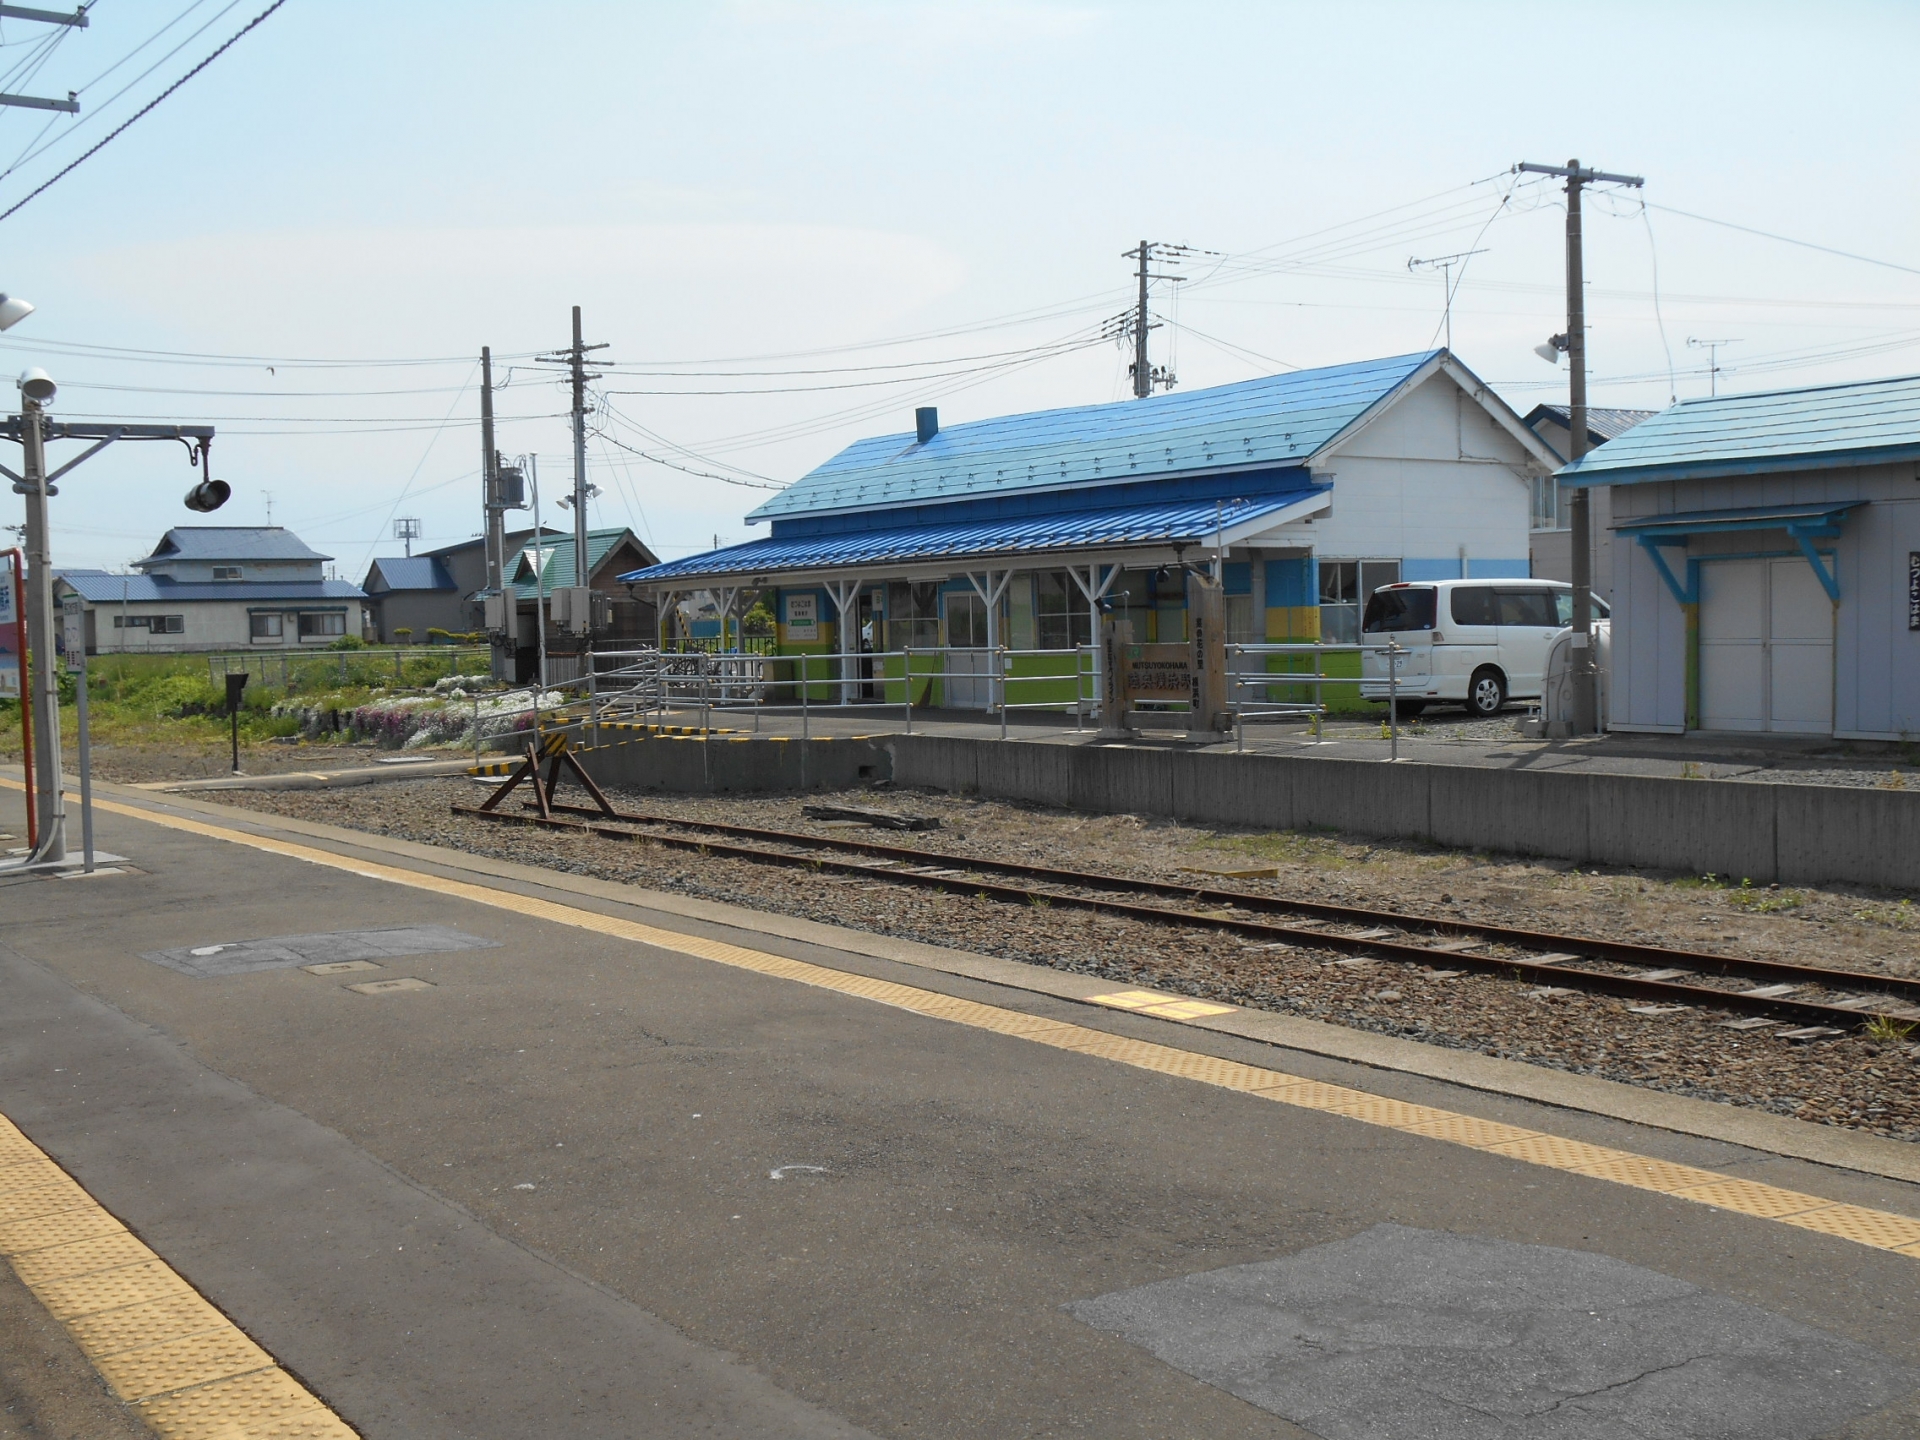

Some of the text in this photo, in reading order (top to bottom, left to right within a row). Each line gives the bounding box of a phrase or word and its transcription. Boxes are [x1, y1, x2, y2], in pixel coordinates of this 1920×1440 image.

[1910, 555, 1920, 627] むつよこはま
[1132, 661, 1187, 669] MUTSUYOKOHAMA
